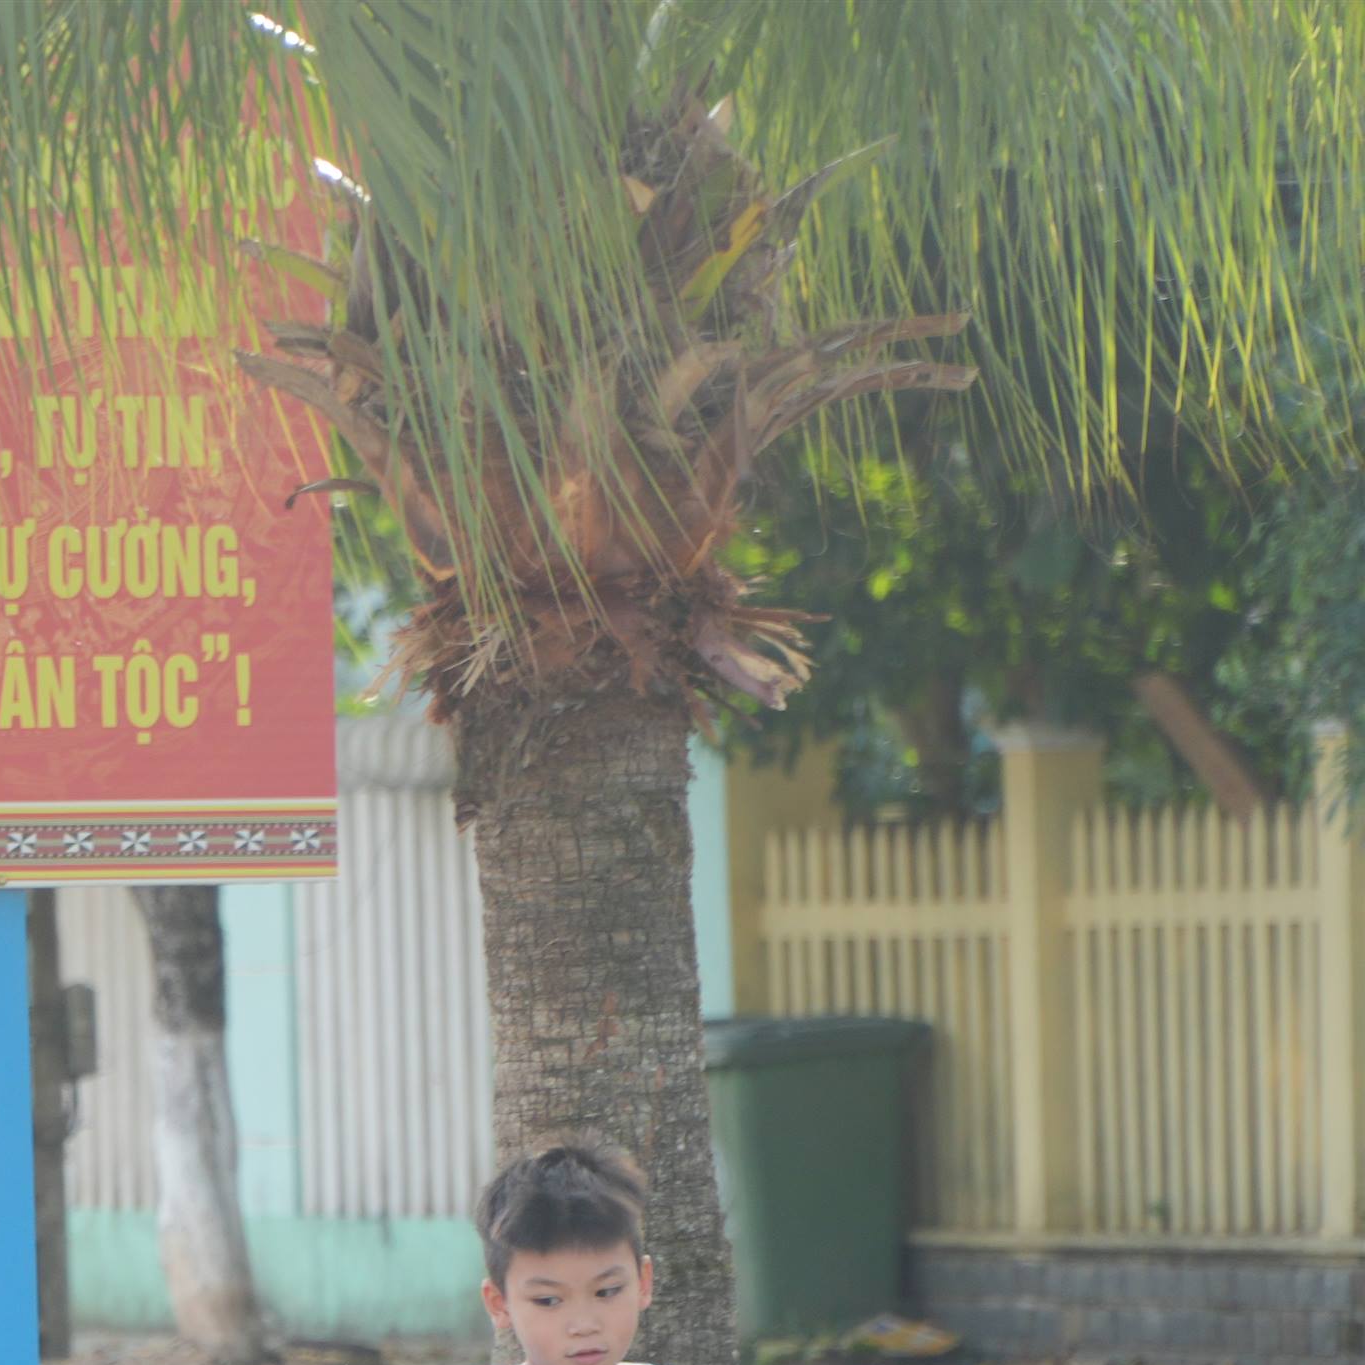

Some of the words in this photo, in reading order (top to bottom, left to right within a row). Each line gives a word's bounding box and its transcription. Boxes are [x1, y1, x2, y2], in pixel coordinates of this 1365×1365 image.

[27, 387, 103, 487] TỰ
[114, 393, 224, 479] TIN,
[48, 506, 257, 606] CƯỜNG,
